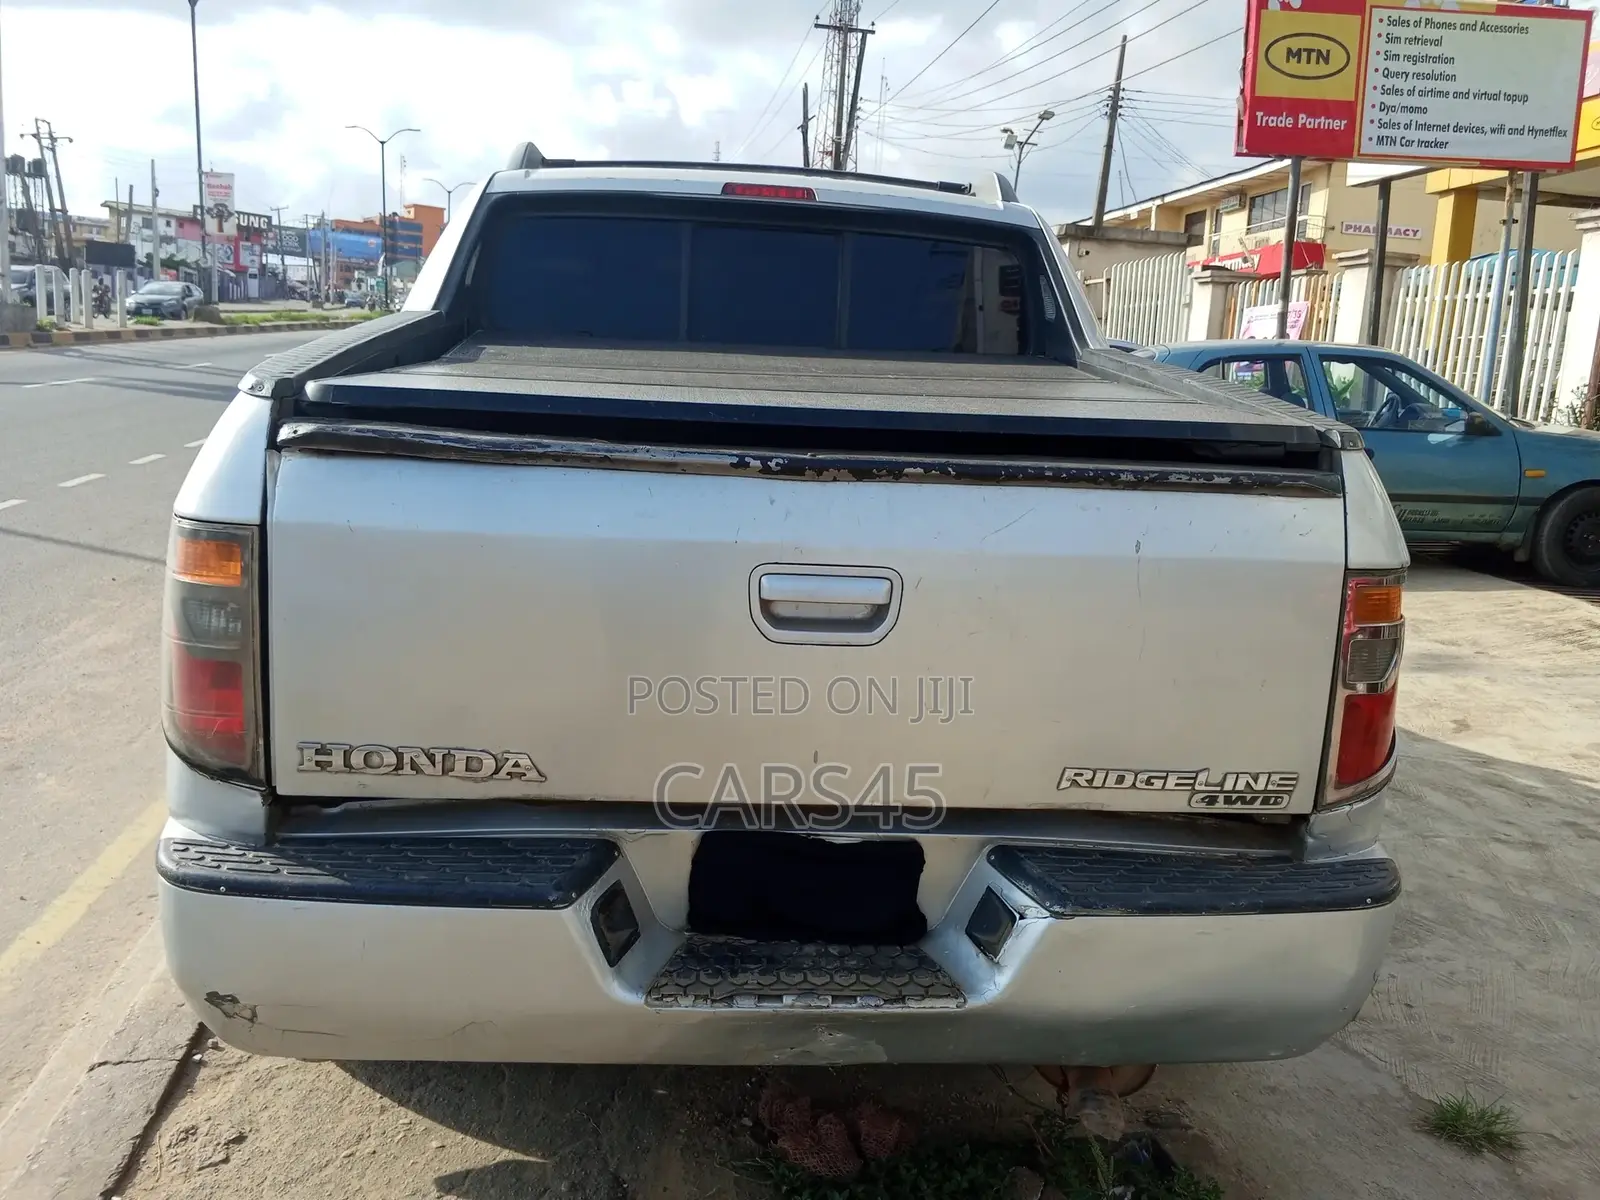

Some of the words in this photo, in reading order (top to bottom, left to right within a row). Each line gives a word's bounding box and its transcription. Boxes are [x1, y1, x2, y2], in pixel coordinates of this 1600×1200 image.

[1386, 15, 1411, 28] Sales
[1413, 17, 1423, 29] of
[1424, 17, 1457, 31] Phones
[1459, 20, 1478, 32] and
[1479, 20, 1529, 35] Accessories
[1385, 32, 1402, 45] Sim
[1404, 35, 1443, 47] retrieval
[1285, 47, 1331, 65] MTN
[1383, 50, 1400, 62] Sim
[1403, 52, 1455, 66] registration
[1382, 67, 1410, 82] Query
[1412, 69, 1457, 82] resolution
[1380, 84, 1404, 97] Sales
[1406, 86, 1416, 98] of
[1418, 86, 1450, 99] airtime
[1452, 88, 1471, 100] and
[1472, 89, 1502, 102] virtual
[1503, 92, 1529, 105] topup
[1379, 101, 1428, 115] Dya/momo
[1255, 111, 1294, 128] Trade
[1297, 113, 1348, 130] Partner
[1377, 118, 1401, 131] Sales
[1403, 119, 1413, 131] of
[1414, 120, 1450, 133] Internet
[1452, 122, 1488, 136] devices,
[1489, 124, 1506, 136] wifi
[1507, 124, 1525, 137] and
[1375, 135, 1397, 147] MTN
[1399, 136, 1415, 148] Car
[1416, 137, 1449, 150] tracker
[297, 742, 547, 782] HONDA
[1057, 767, 1298, 791] RIDGELINE
[1199, 794, 1283, 807] 4WD
